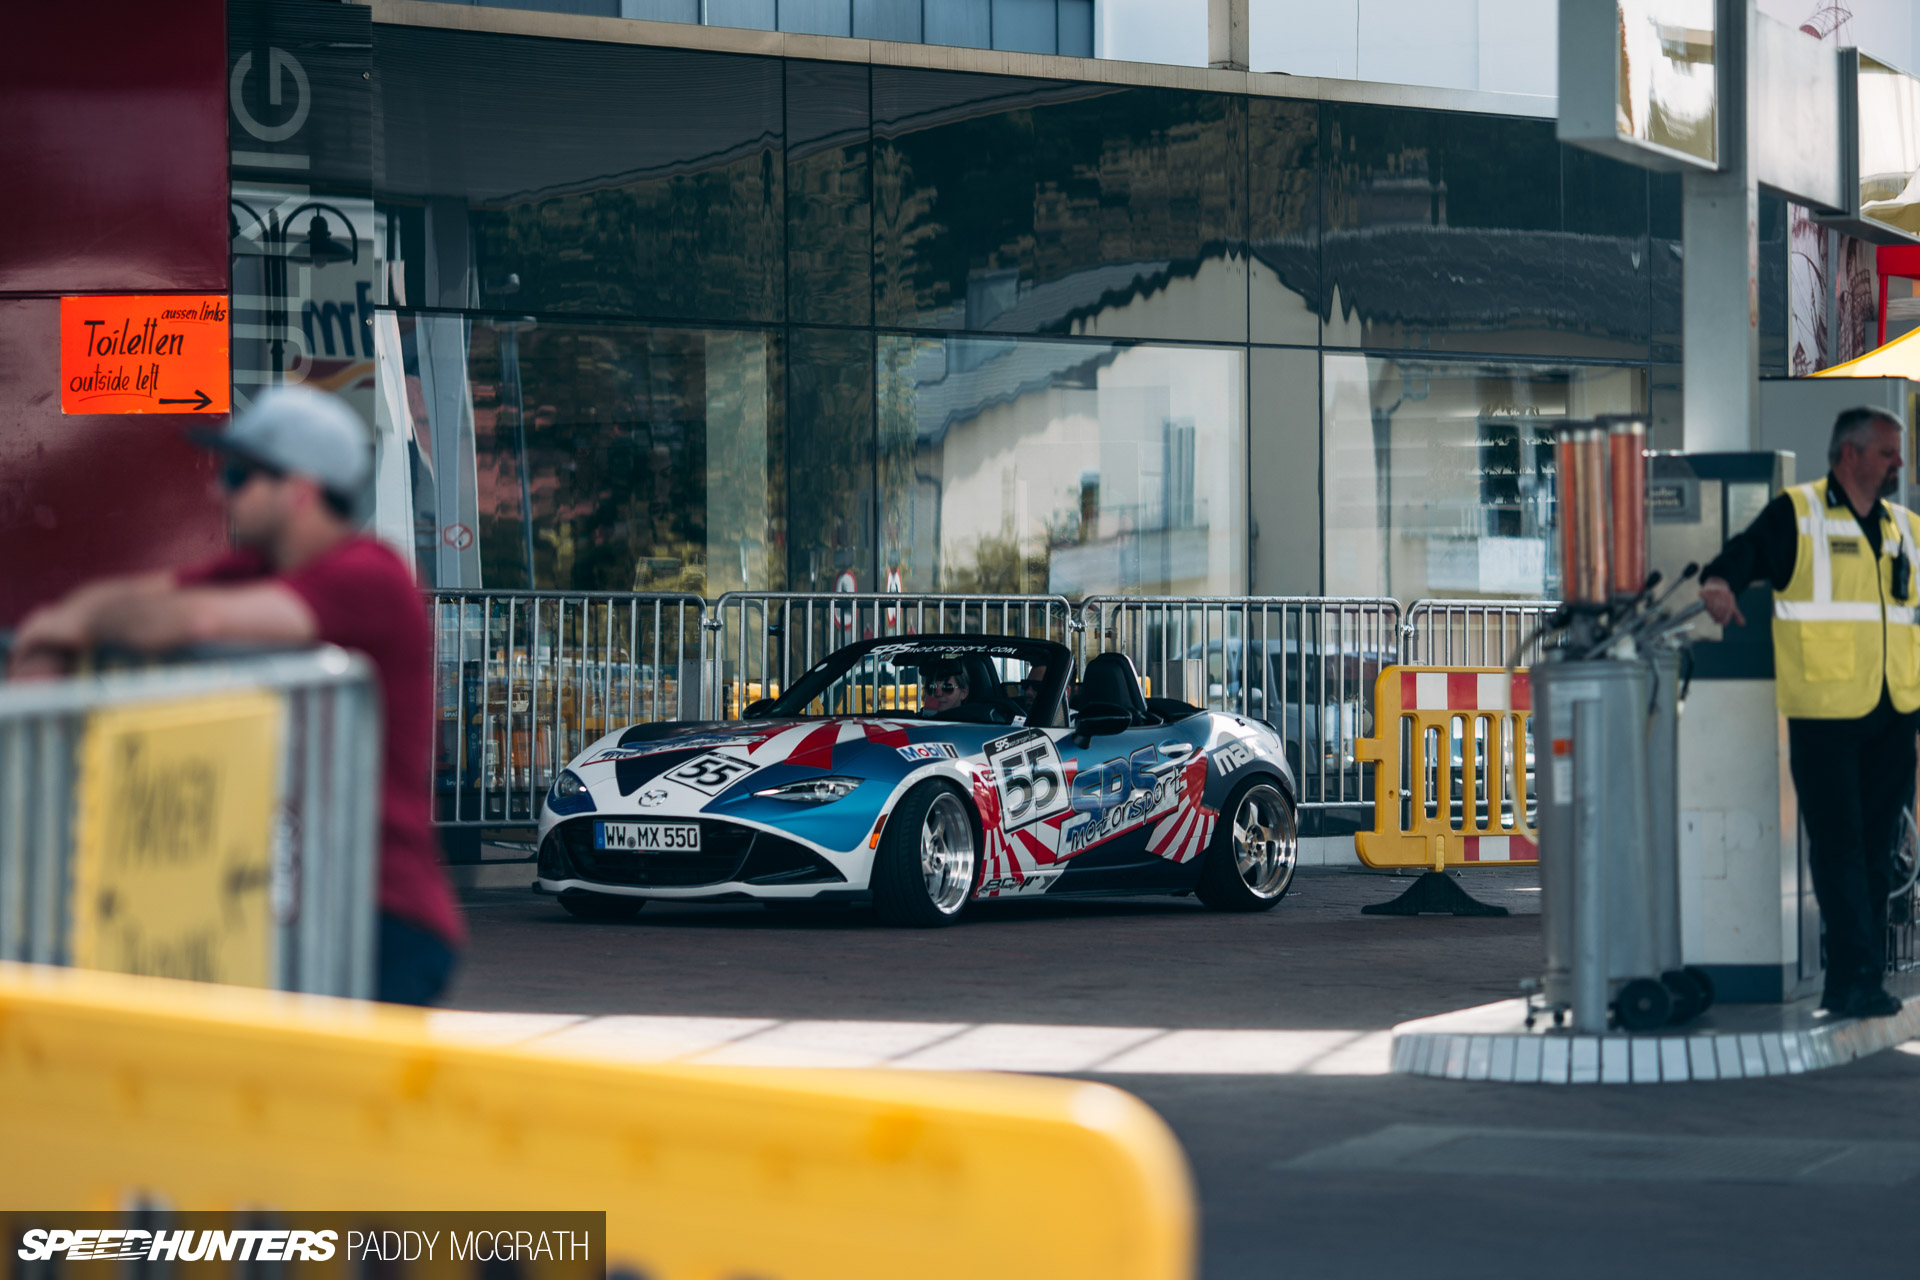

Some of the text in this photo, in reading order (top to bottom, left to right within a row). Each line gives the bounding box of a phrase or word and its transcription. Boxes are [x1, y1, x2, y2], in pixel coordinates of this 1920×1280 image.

[231, 46, 312, 412] ULNIG
[161, 301, 227, 322] aussen links
[84, 317, 184, 357] Toiletten
[70, 362, 160, 398] outside left
[901, 743, 944, 761] Mobil
[675, 757, 745, 786] 55
[1000, 743, 1060, 820] 55
[1070, 766, 1184, 852] motorsport
[605, 826, 698, 848] WW MX 550
